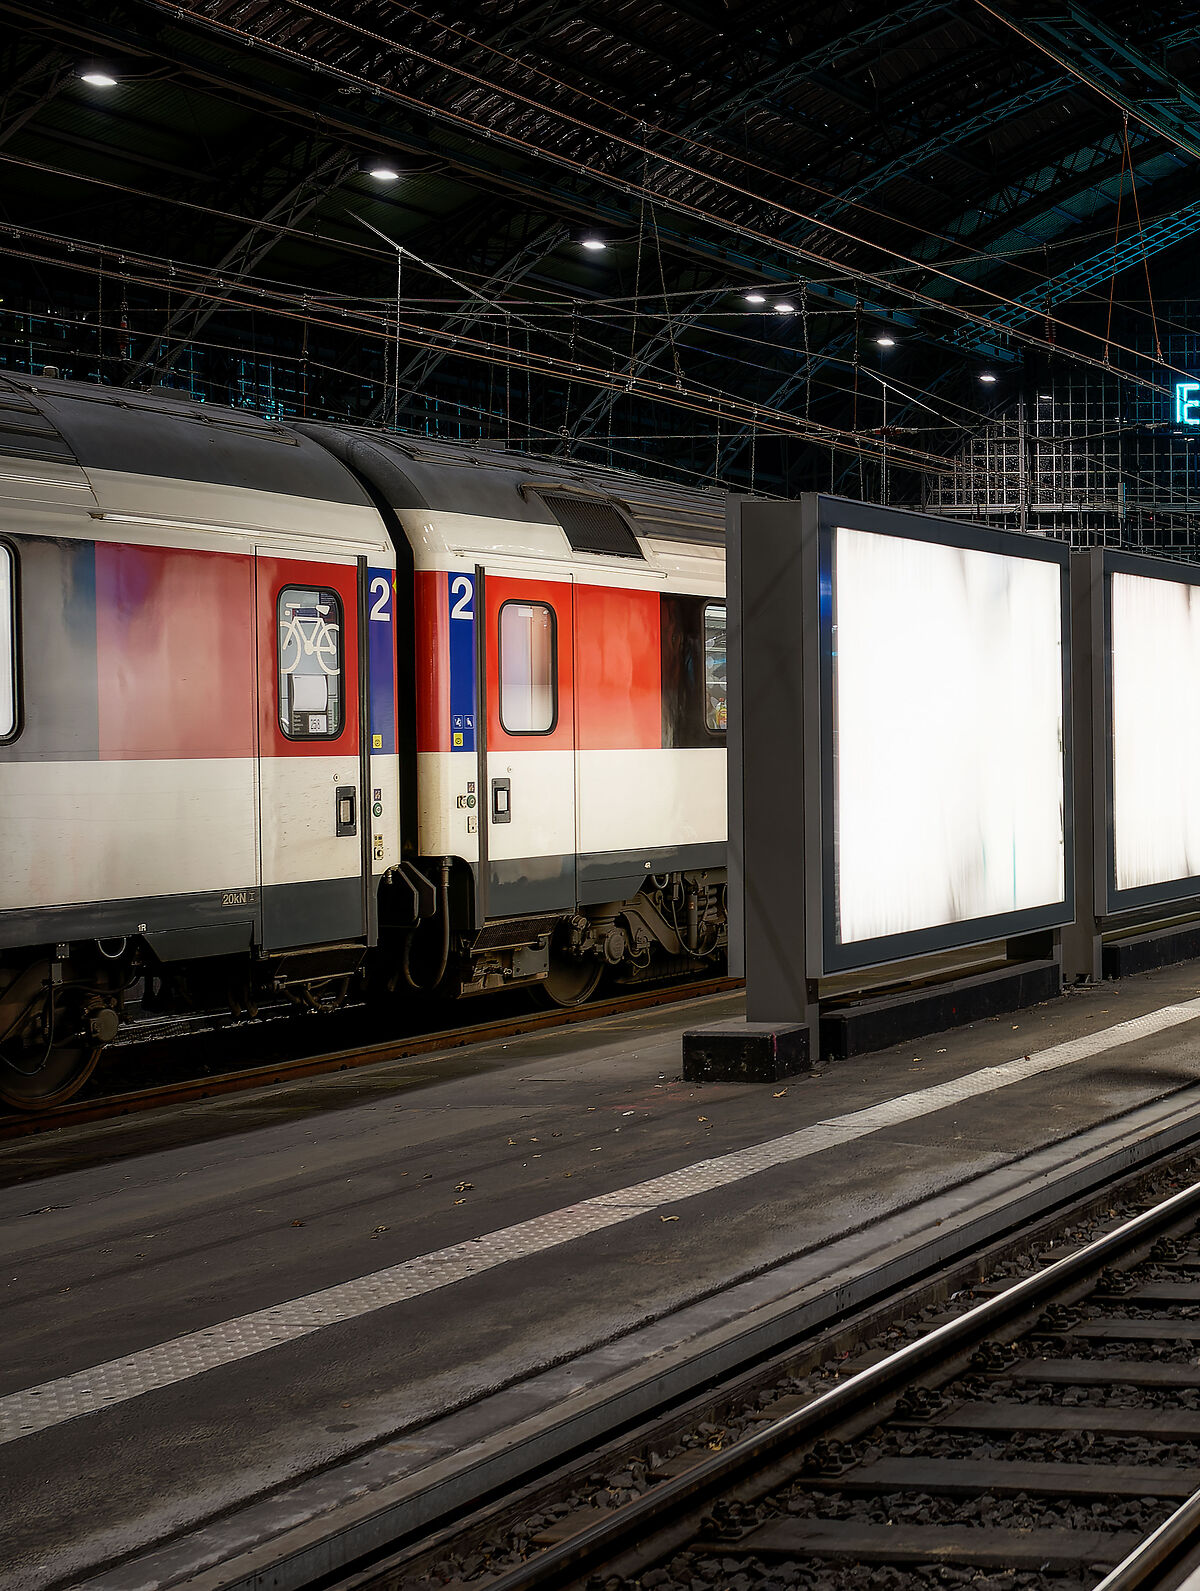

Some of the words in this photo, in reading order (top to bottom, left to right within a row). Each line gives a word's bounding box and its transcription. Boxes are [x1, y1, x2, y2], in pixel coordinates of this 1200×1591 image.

[369, 577, 391, 622] 2
[450, 576, 475, 620] 2
[222, 892, 247, 906] 20kN
[137, 923, 147, 932] 1R
